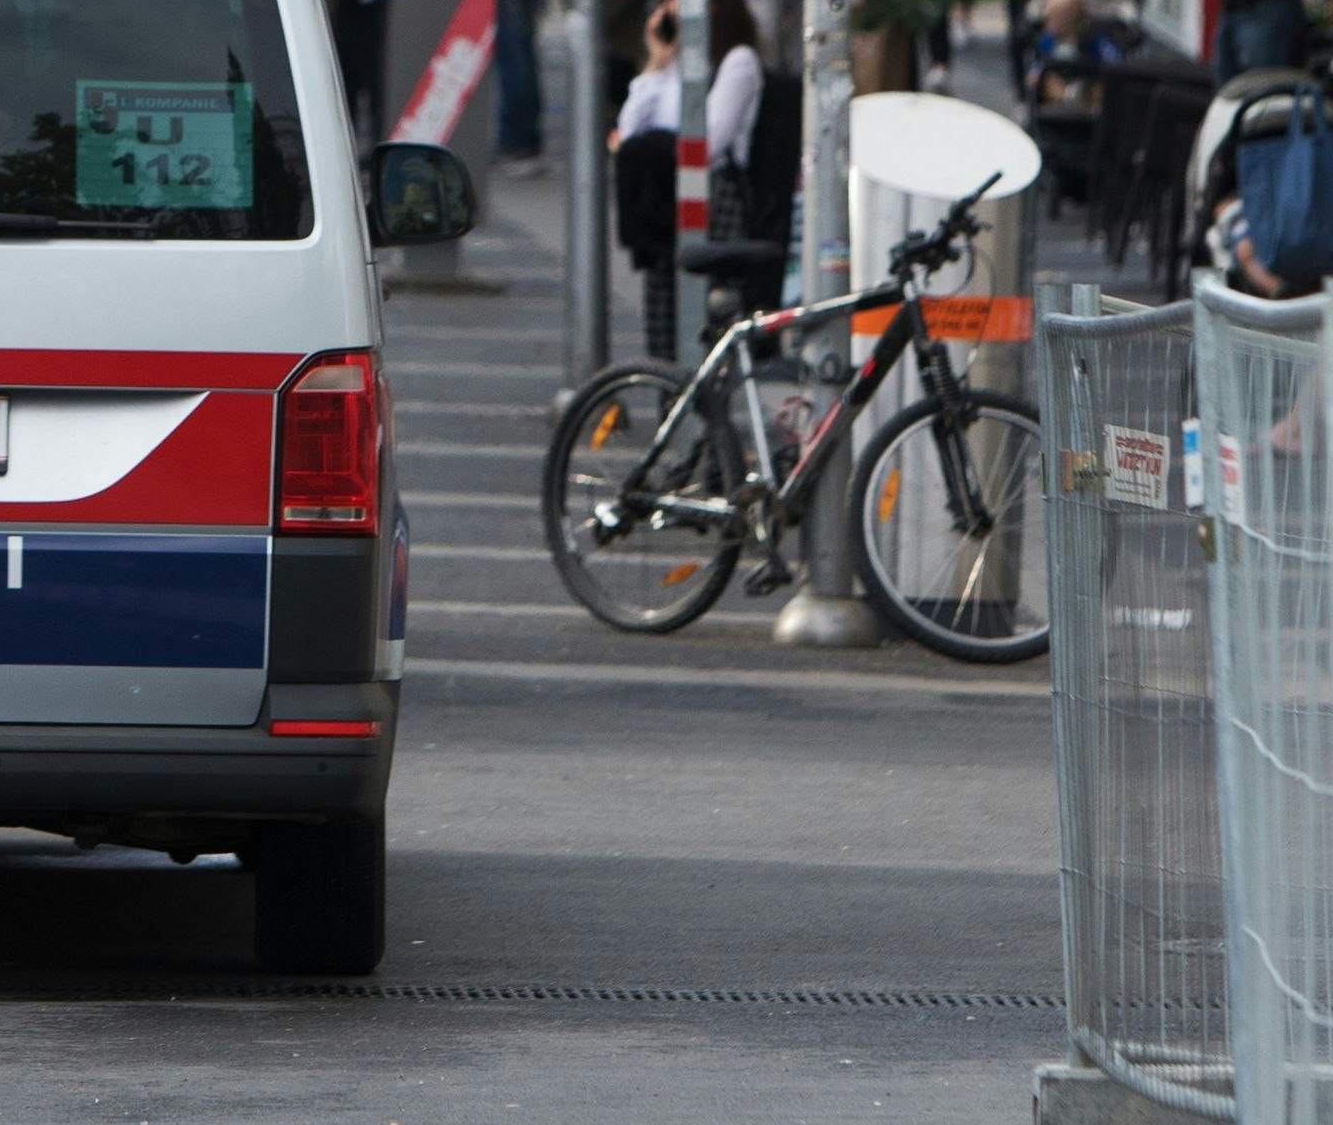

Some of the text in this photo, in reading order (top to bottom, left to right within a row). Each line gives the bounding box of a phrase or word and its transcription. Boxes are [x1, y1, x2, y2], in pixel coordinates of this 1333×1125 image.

[135, 96, 219, 109] KOMPANIE
[136, 116, 184, 146] U
[112, 152, 212, 186] 112
